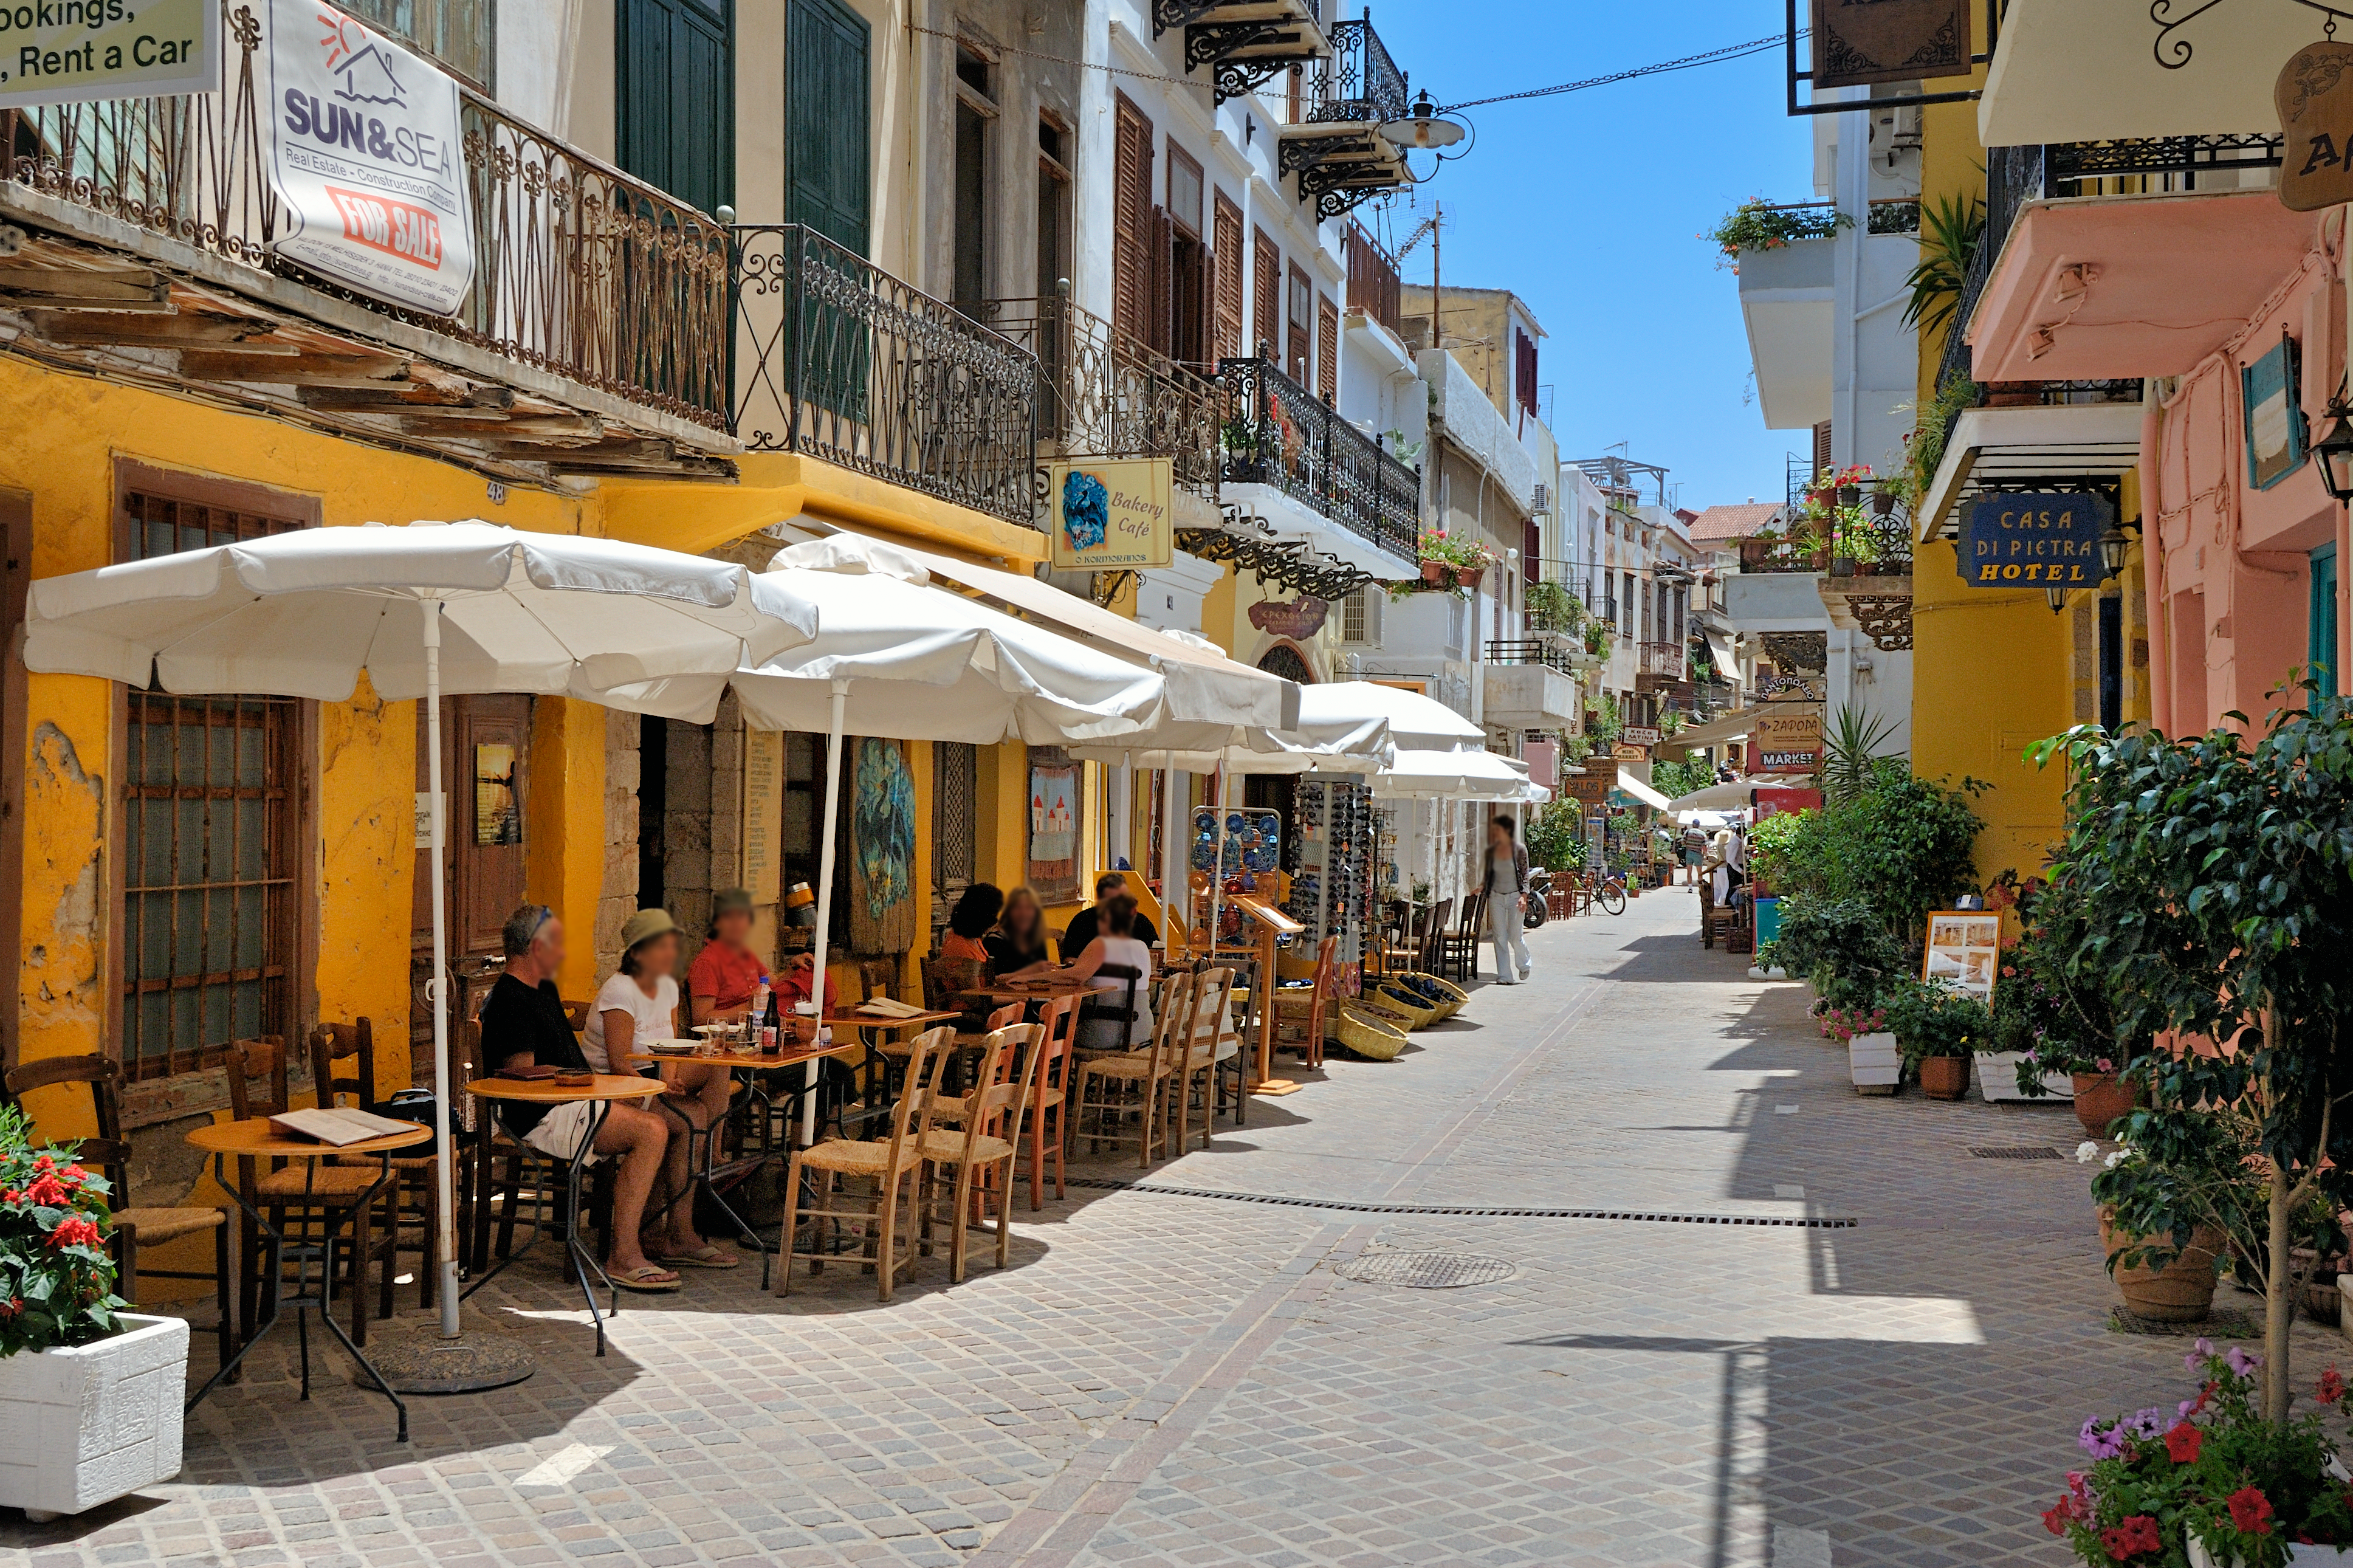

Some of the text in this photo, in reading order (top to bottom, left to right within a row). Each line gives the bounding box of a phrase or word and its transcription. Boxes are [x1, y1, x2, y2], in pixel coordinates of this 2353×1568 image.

[20, 35, 193, 77] Rent a Car
[284, 88, 453, 182] SUN&SEA
[286, 148, 311, 167] Real
[312, 156, 346, 177] Estate
[357, 168, 426, 196] Construction
[427, 186, 456, 213] Company
[335, 193, 439, 265] FOR SALE
[487, 482, 504, 500] 48
[1111, 491, 1164, 520] Bakery
[1118, 517, 1150, 539] Café
[2001, 511, 2072, 529] CASA
[1977, 540, 2092, 556] DI PIETRA
[1084, 554, 1147, 563] KORMORANOS
[1979, 563, 2085, 581] HOTEL
[1761, 677, 1814, 700] ΠΑΝΤΟΠΩΛΕΙΟ
[1773, 720, 1817, 732] ΖΑΦΟΡΑ
[1763, 753, 1813, 765] MARKET
